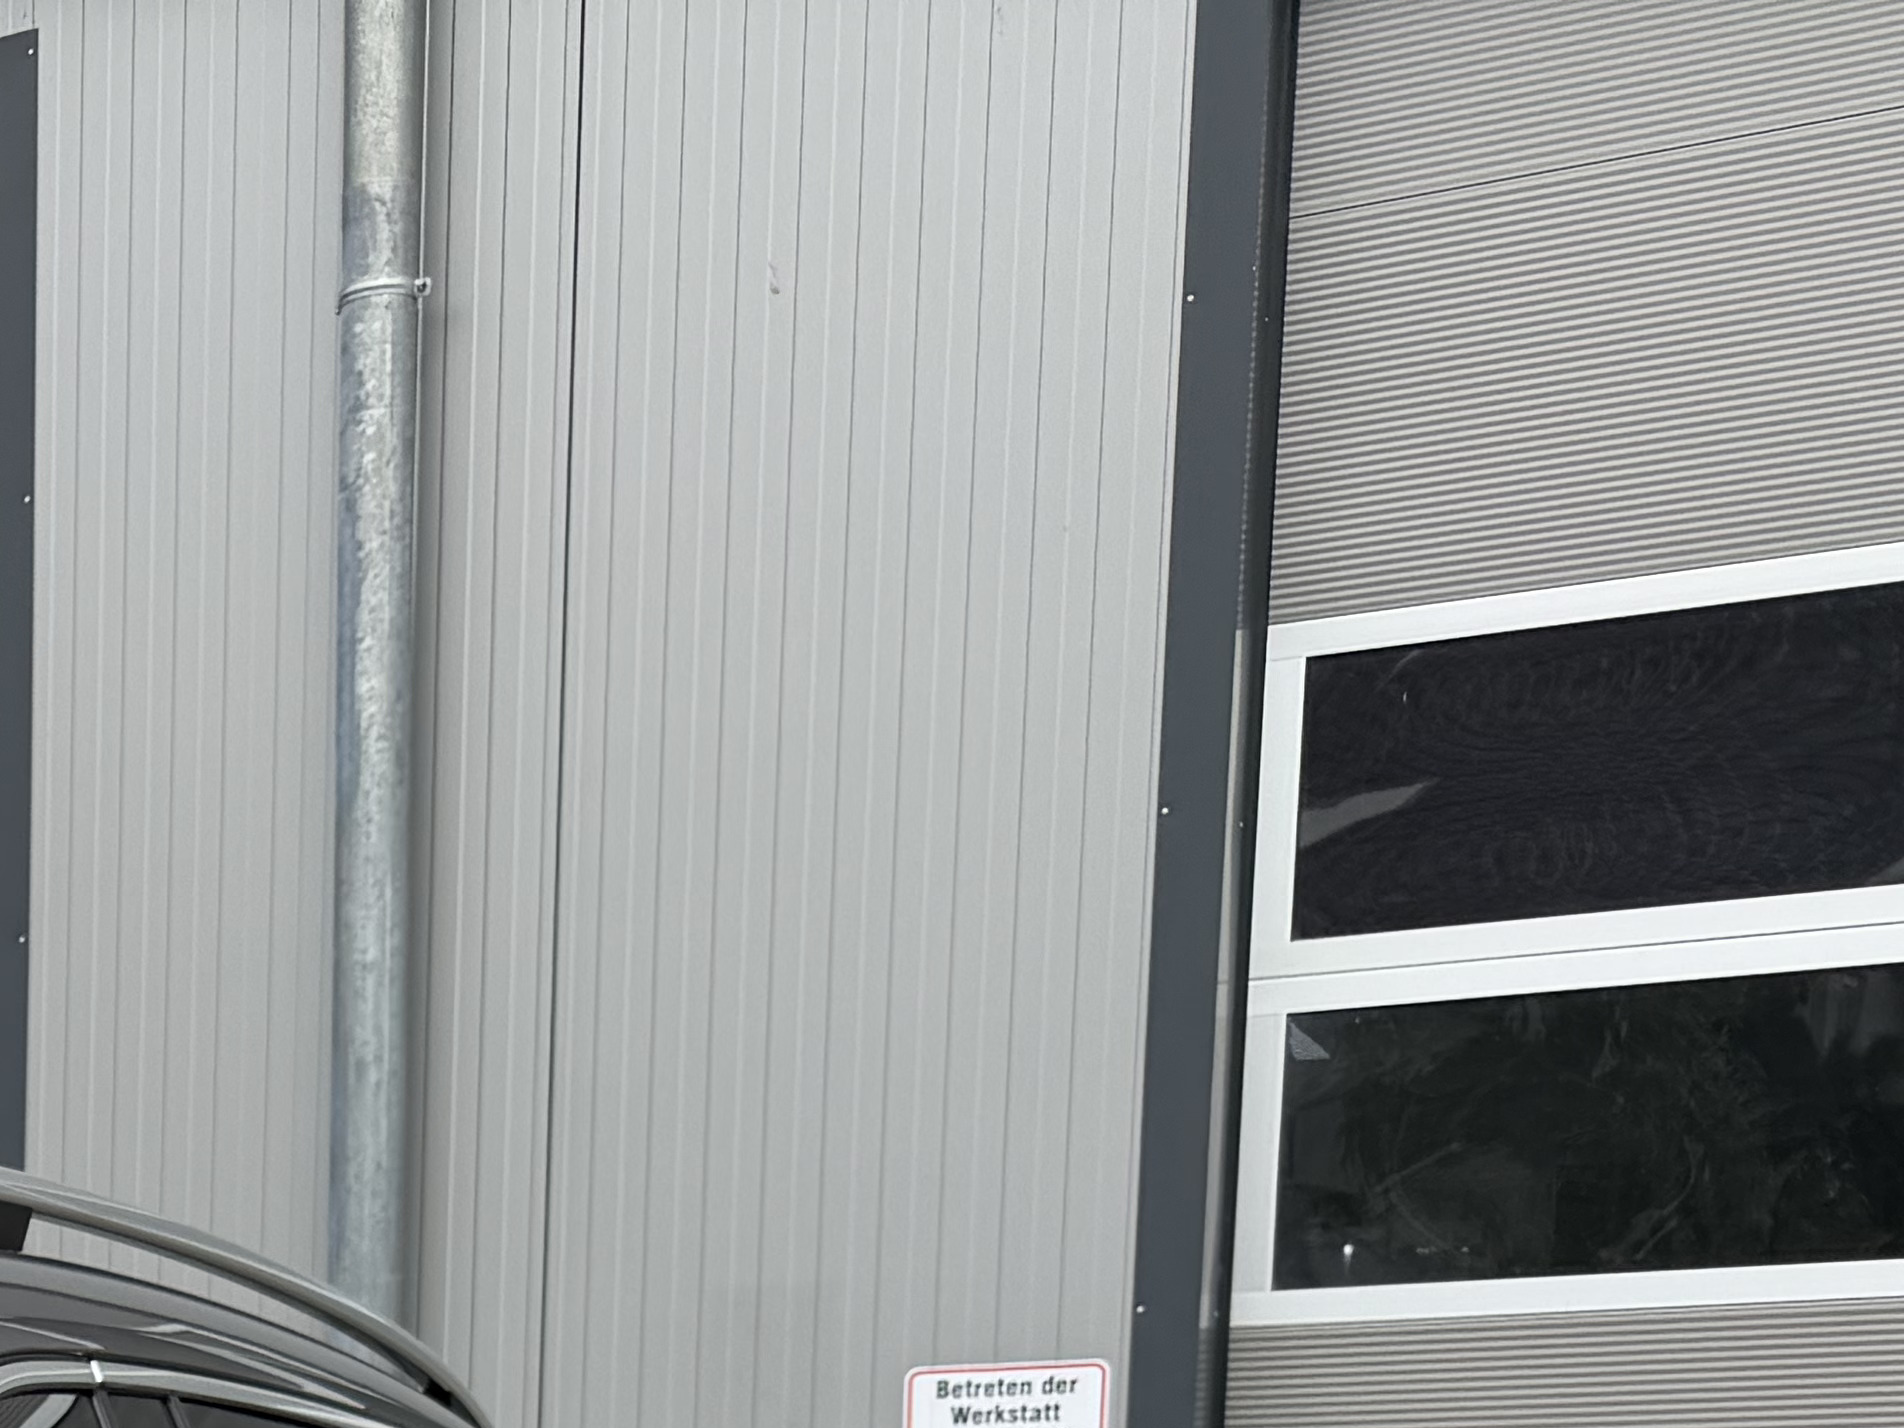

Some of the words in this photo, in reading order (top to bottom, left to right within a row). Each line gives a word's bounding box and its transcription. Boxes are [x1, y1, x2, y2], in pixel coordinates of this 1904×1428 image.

[936, 1378, 1033, 1399] Betreten
[1042, 1376, 1078, 1395] der
[951, 1404, 1061, 1425] Werkstatt
